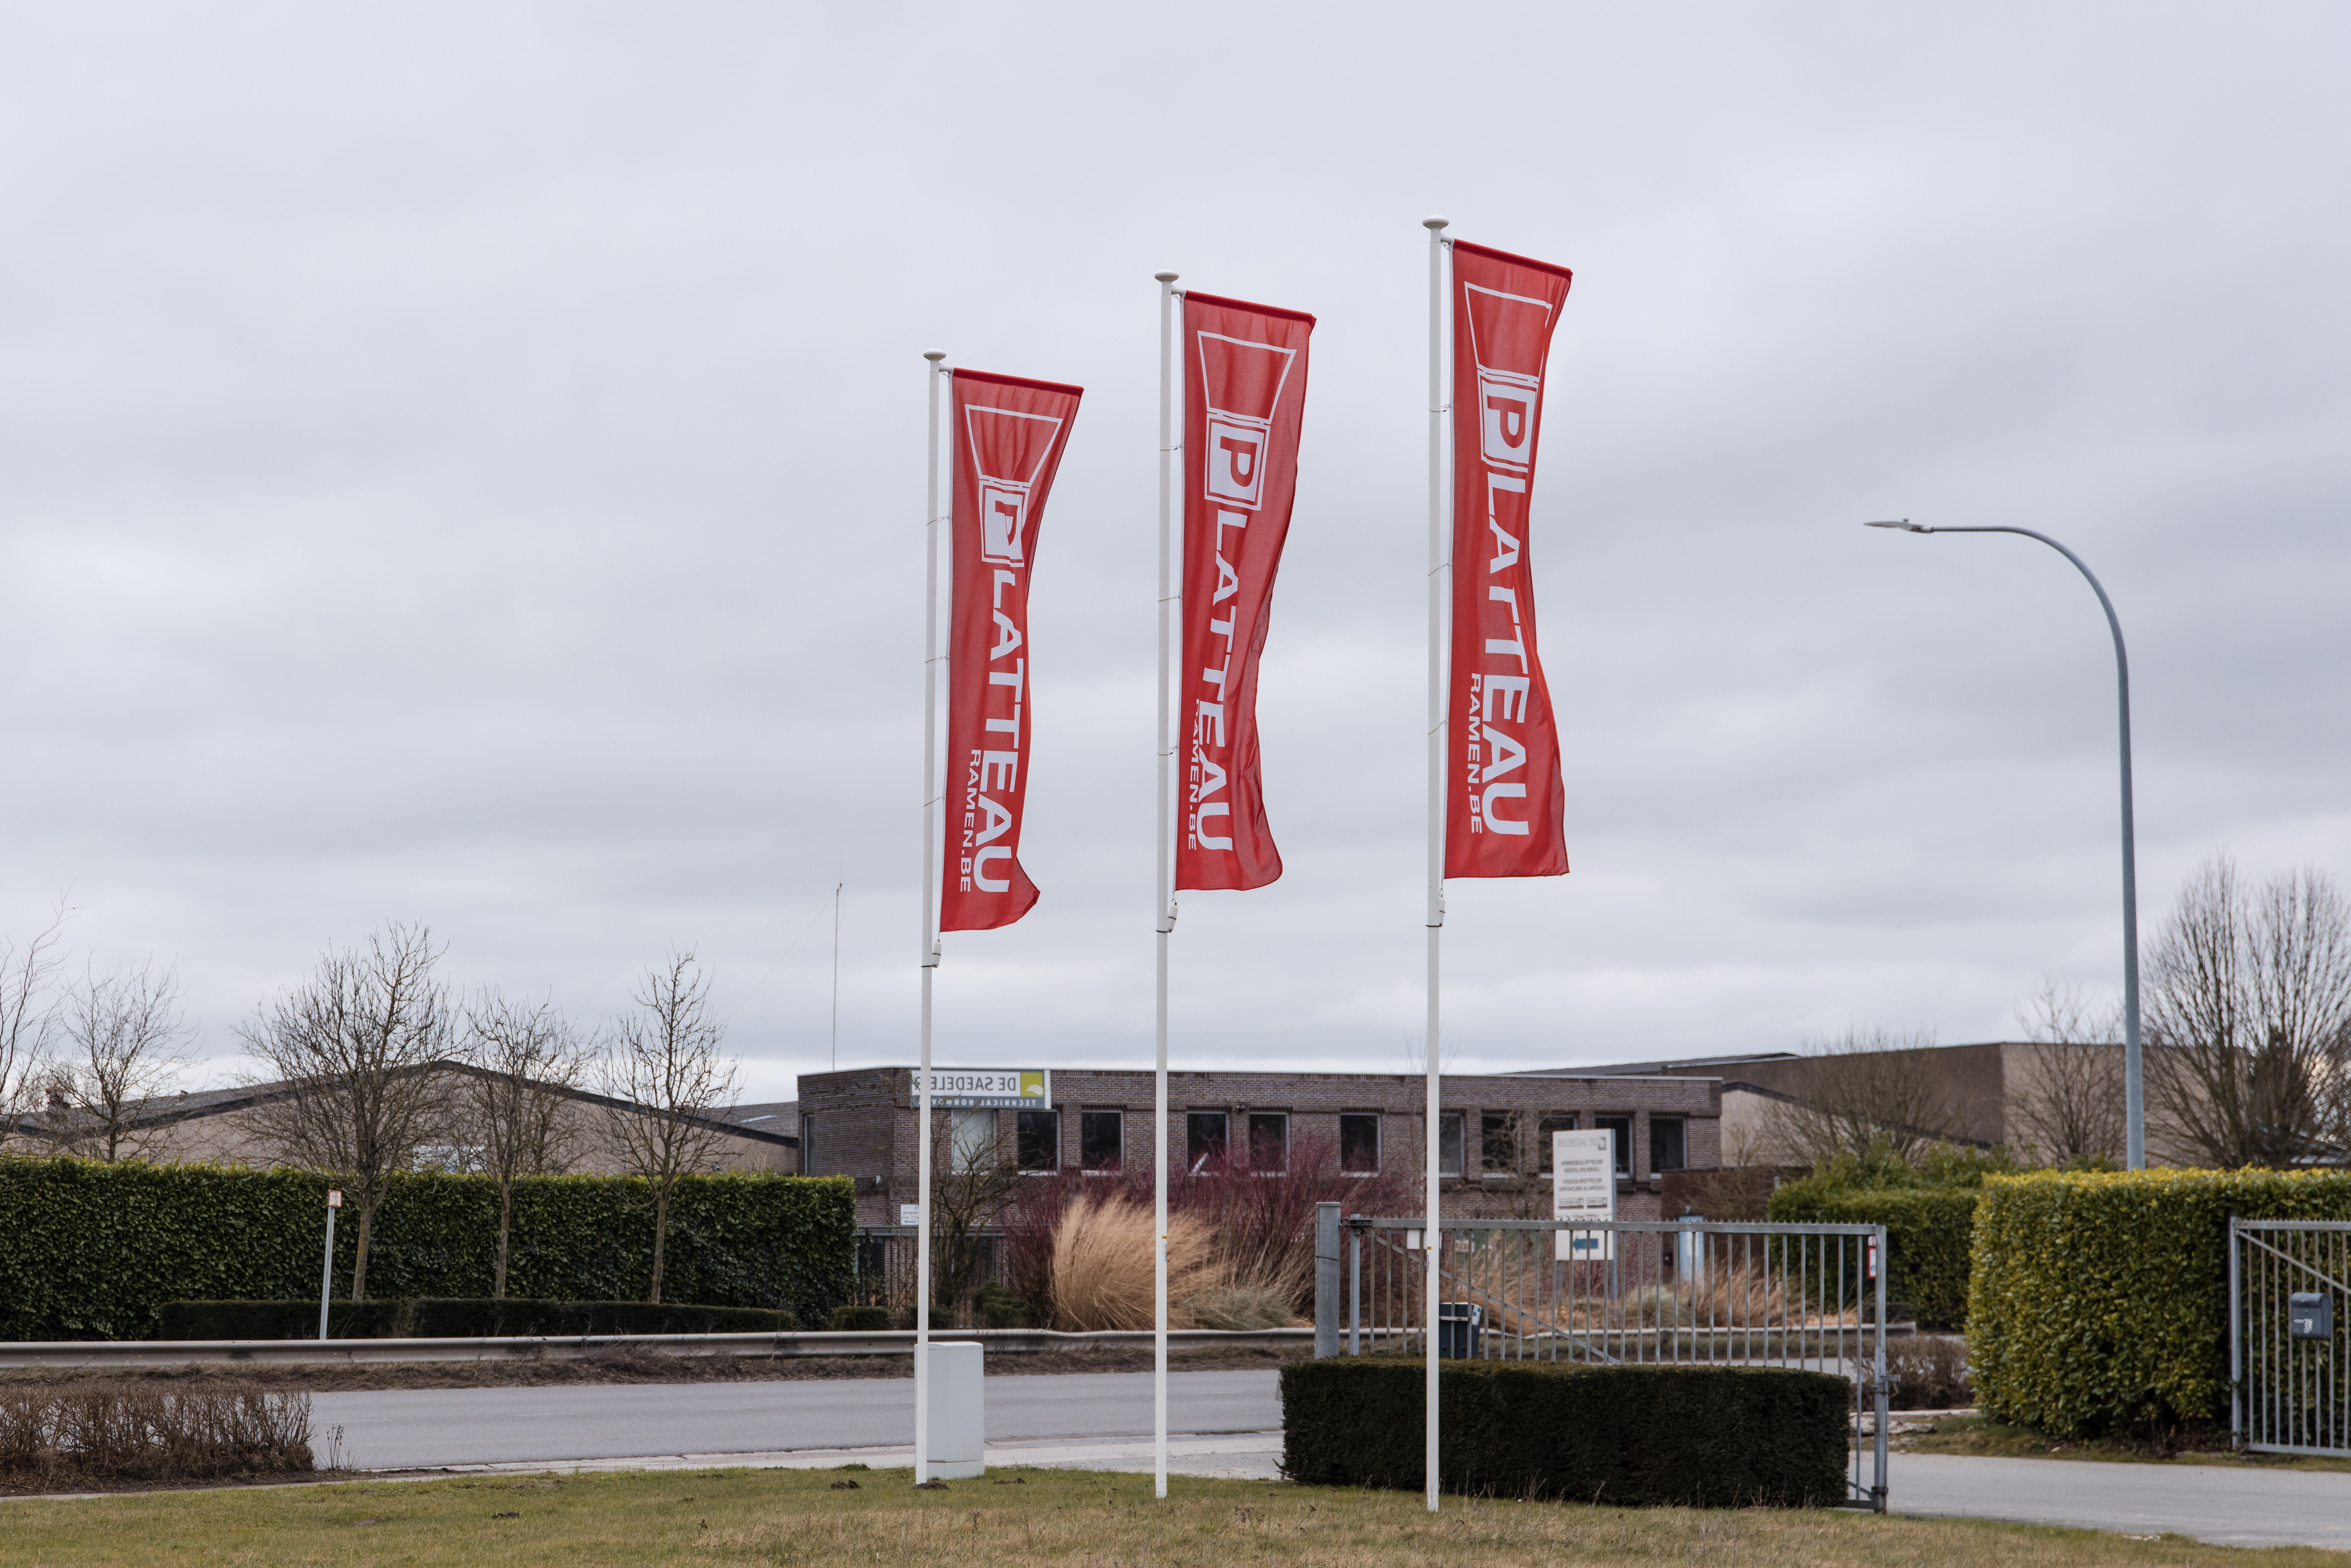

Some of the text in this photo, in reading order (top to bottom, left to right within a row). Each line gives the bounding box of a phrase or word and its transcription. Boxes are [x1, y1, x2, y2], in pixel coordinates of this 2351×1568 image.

[1197, 435, 1258, 851] PLATTEAU
[1467, 673, 1482, 834] RAMEN.BE
[1482, 394, 1530, 835] PLATTEAU
[960, 749, 982, 892] RAMEN.BE
